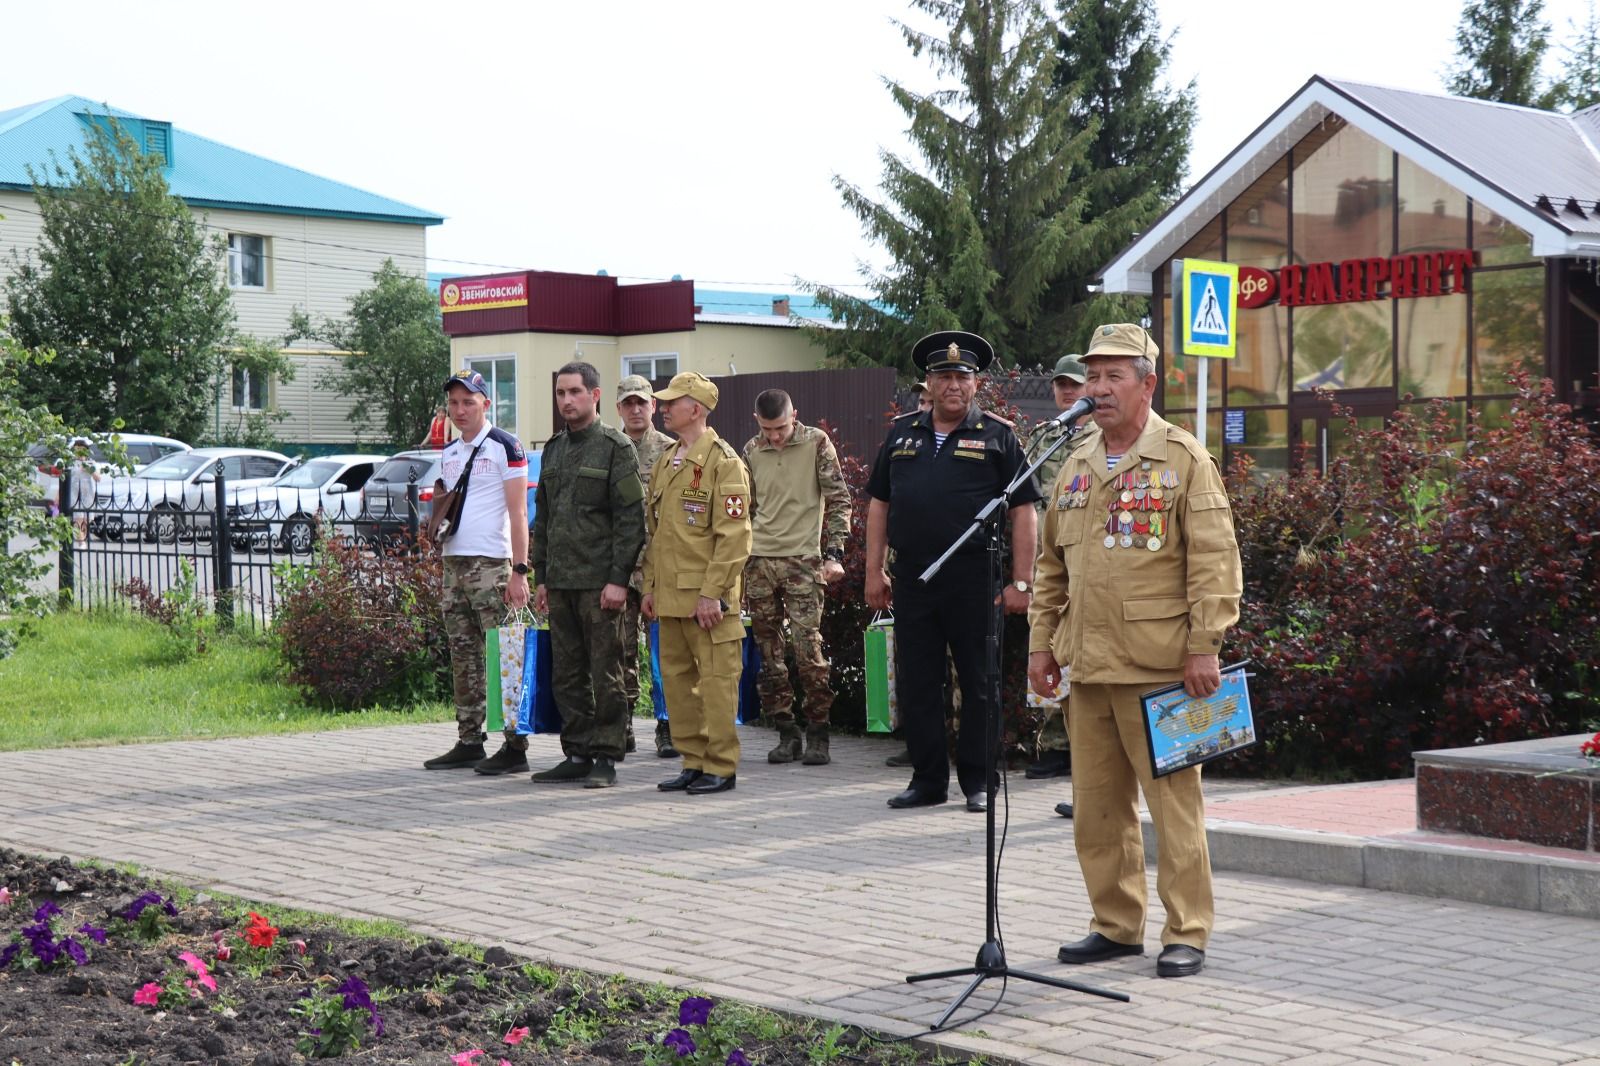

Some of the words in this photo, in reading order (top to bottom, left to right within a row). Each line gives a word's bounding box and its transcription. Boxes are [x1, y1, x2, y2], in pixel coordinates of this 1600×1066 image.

[461, 283, 523, 301] ЗВЕНИГОВСКИЙ
[1237, 275, 1268, 301] фе
[1278, 249, 1476, 306] АМАРАНТ
